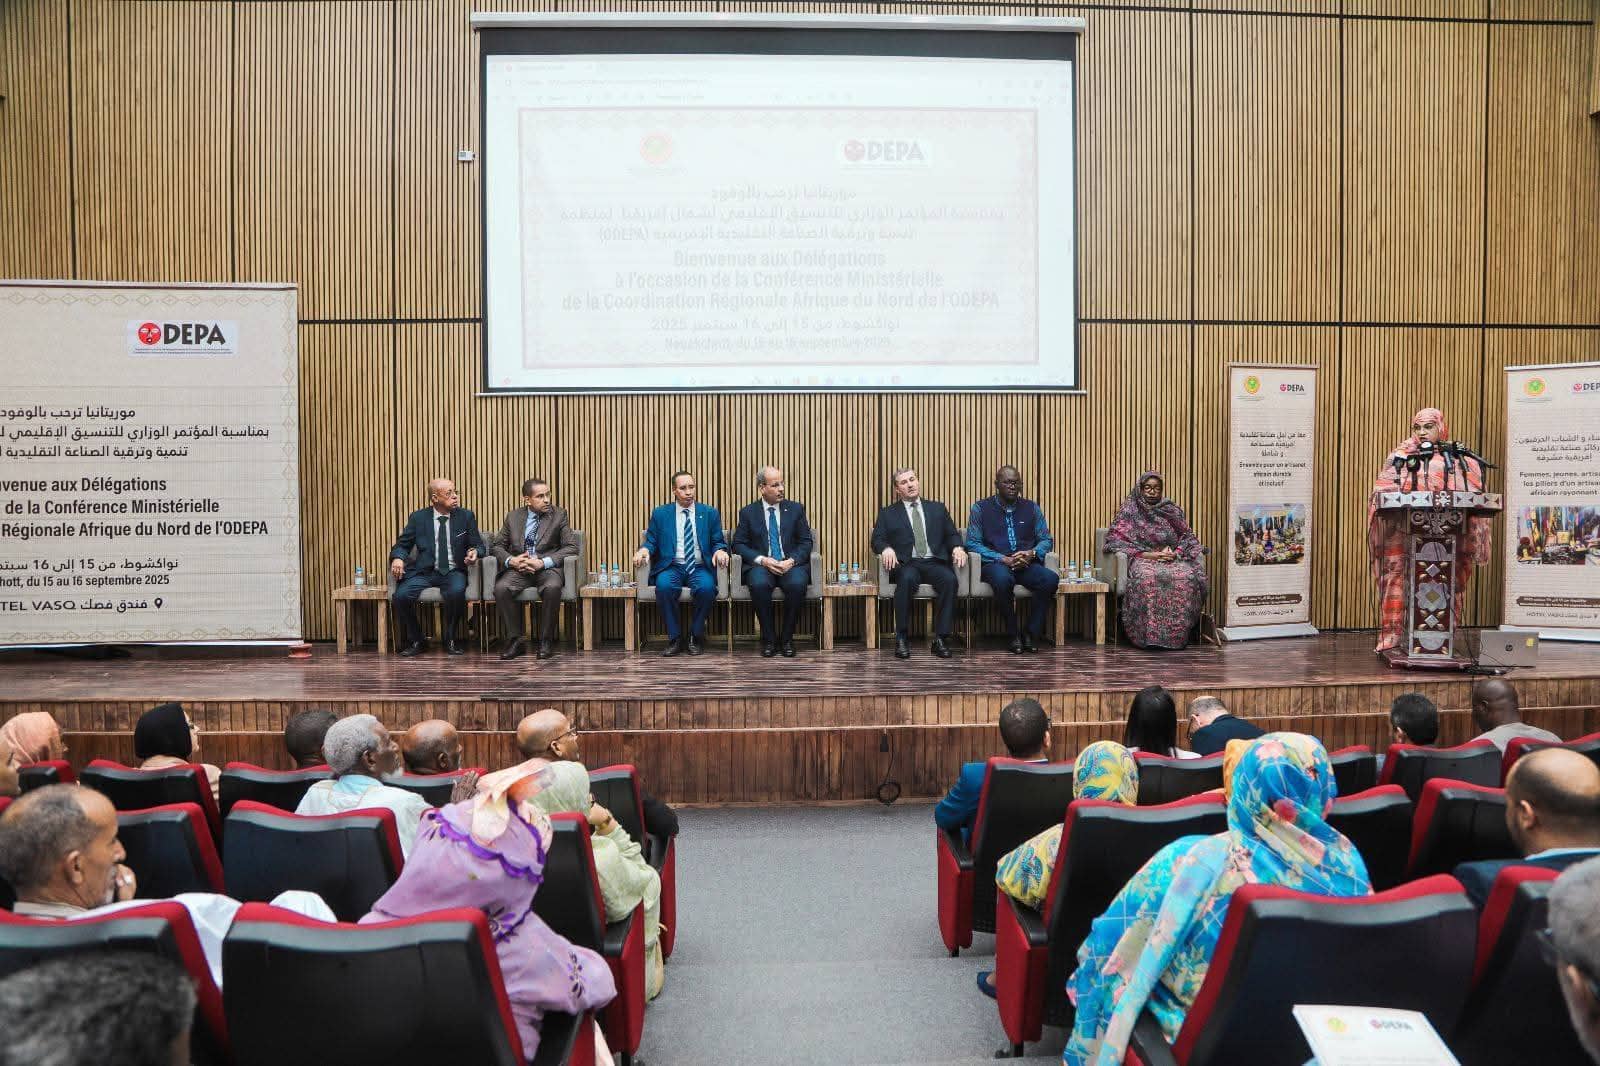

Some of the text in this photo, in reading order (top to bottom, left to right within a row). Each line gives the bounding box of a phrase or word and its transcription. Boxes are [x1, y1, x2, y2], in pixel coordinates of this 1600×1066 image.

[674, 250, 756, 267] Bienvenue
[761, 252, 788, 267] aux
[616, 269, 944, 288] à l'occasion de la Conférence Ministérielle
[562, 294, 582, 310] de
[586, 292, 599, 310] la
[604, 292, 706, 310] Coordination
[793, 292, 848, 312] Afrique
[853, 292, 872, 308] du
[878, 292, 914, 308] Nord
[918, 292, 938, 308] de
[0, 406, 136, 420] موريتانيا ترحب بالوفود
[9, 426, 67, 443] الإقليمي
[72, 426, 124, 441] للتنسيق
[128, 426, 169, 443] الوزاري
[173, 425, 218, 440] المؤتمر
[222, 425, 269, 440] بمناسبة
[6, 446, 61, 460] التقليدية
[64, 446, 109, 458] الصناعة
[113, 446, 152, 460] وترقية
[156, 446, 188, 459] تنمية
[51, 480, 78, 492] aux
[82, 476, 167, 495] Délégations
[5, 498, 220, 514] de la Conférence Ministérielle
[2, 520, 268, 541] Régionale Afrique du Nord de l'ODEPA
[0, 560, 28, 573] سبتم
[33, 560, 49, 570] 16
[52, 559, 74, 572] إلى
[80, 559, 94, 570] 15
[98, 563, 116, 572] من
[0, 576, 24, 588] hott,
[27, 576, 40, 586] du
[44, 576, 54, 586] 15
[73, 576, 82, 586] 16
[86, 576, 142, 588] septembre
[145, 574, 170, 584] 2025
[0, 600, 76, 611] TEL VASQ
[80, 599, 148, 612] فندق فصك
